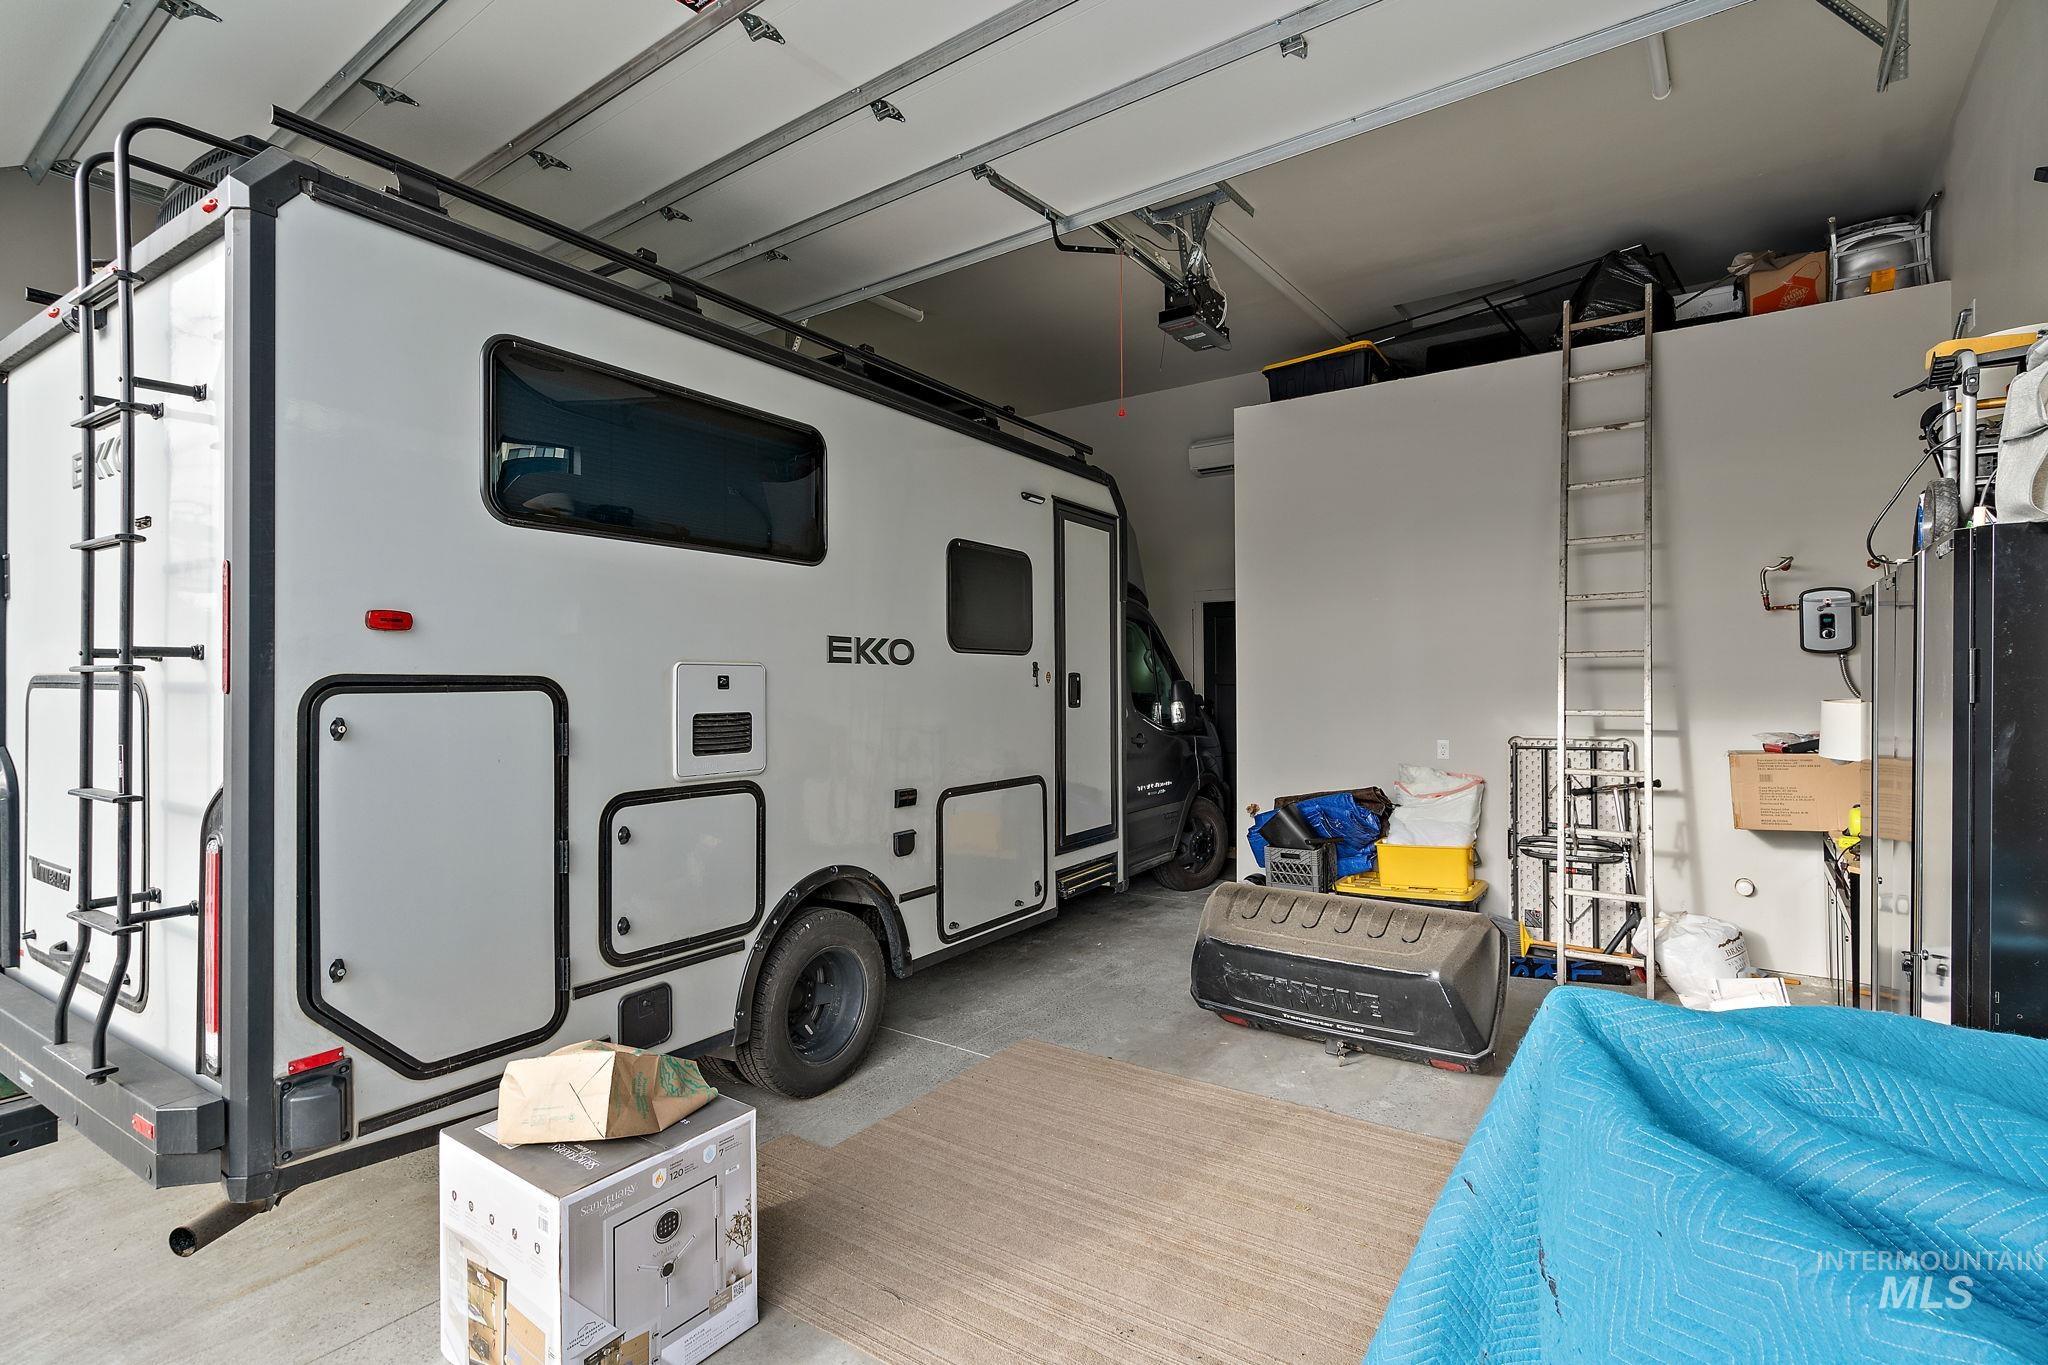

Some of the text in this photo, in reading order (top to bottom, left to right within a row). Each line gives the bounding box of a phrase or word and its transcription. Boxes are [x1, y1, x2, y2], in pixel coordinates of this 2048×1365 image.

[826, 635, 915, 666] EKKO
[1281, 1012, 1334, 1028] Transporter
[669, 1168, 684, 1181] 120
